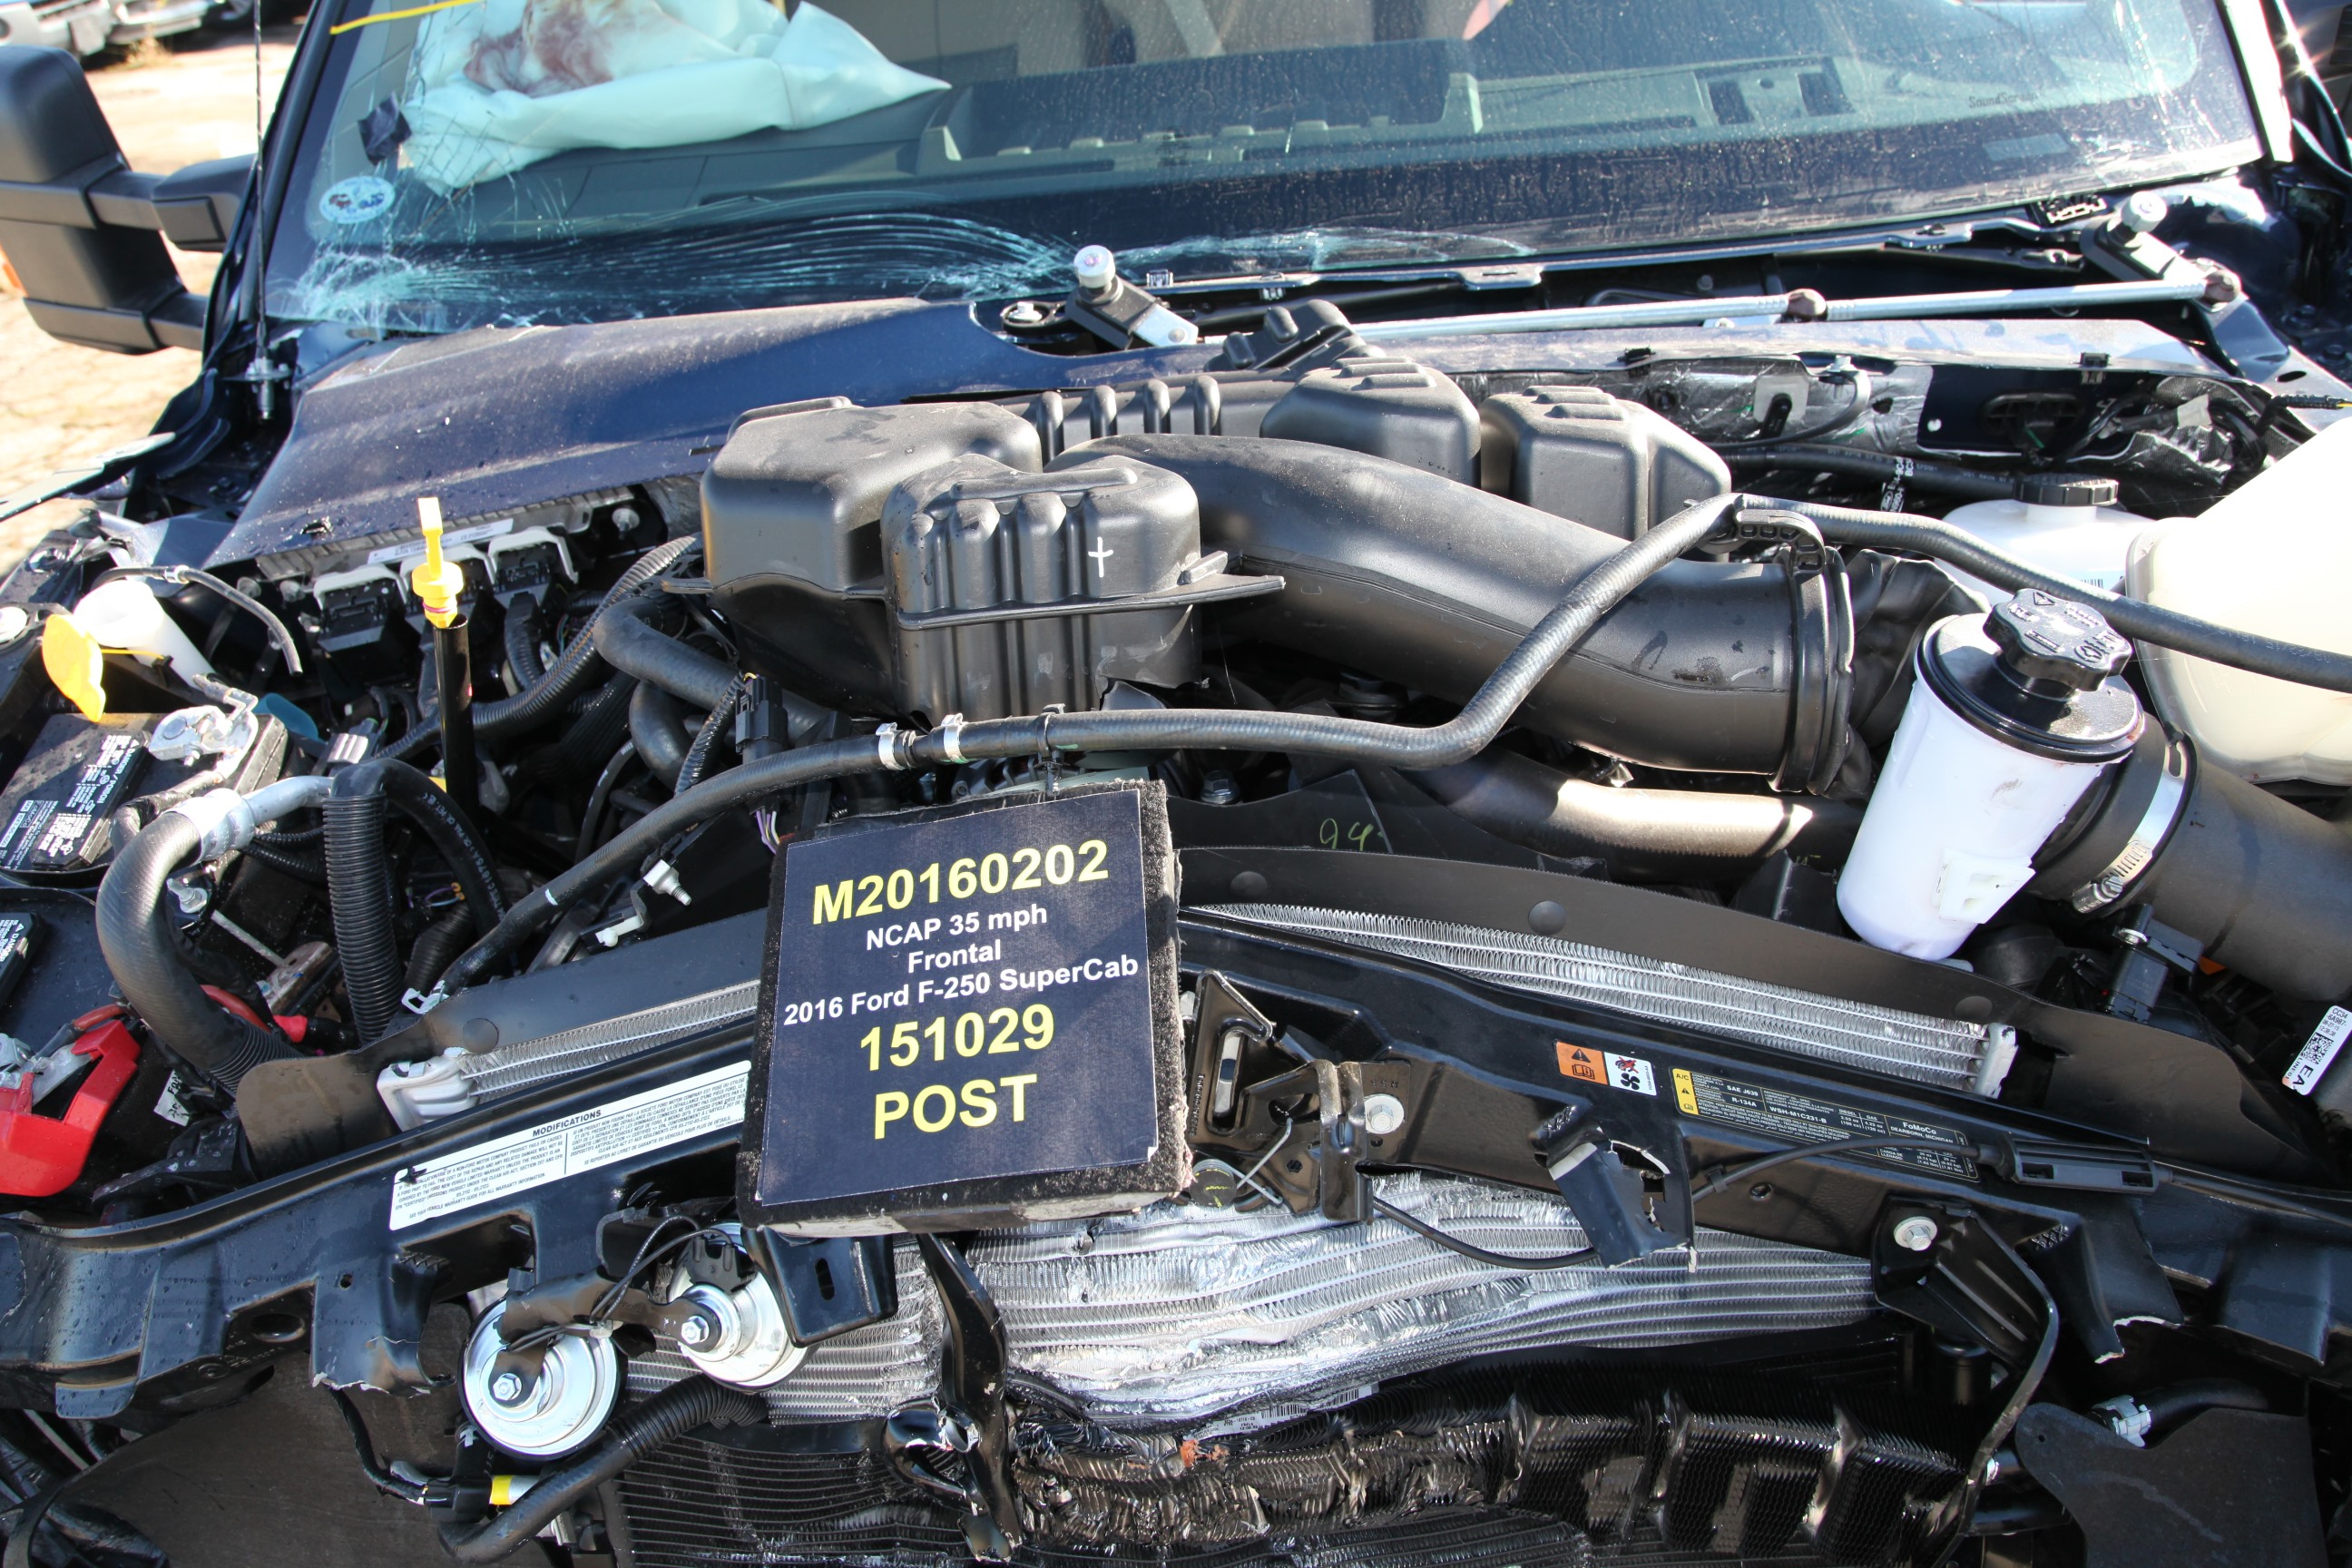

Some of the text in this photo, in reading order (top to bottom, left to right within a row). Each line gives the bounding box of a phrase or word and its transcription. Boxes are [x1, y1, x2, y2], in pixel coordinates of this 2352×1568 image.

[812, 838, 1109, 925] M20160202
[867, 904, 1047, 950] NCAP 35 mph
[907, 941, 1001, 973] Frontal
[783, 956, 1139, 1026] 2016 Ford F-250 SuperCab
[2332, 1007, 2348, 1019] CC34
[860, 1004, 1054, 1072] 151029
[1726, 1084, 1740, 1093] SAE
[2292, 1064, 2314, 1085] EA
[874, 1073, 1037, 1140] POST
[1731, 1096, 1757, 1107] R-134A
[533, 1110, 602, 1136] MODIFICATIONS
[1902, 1121, 1936, 1134] FoMoCo
